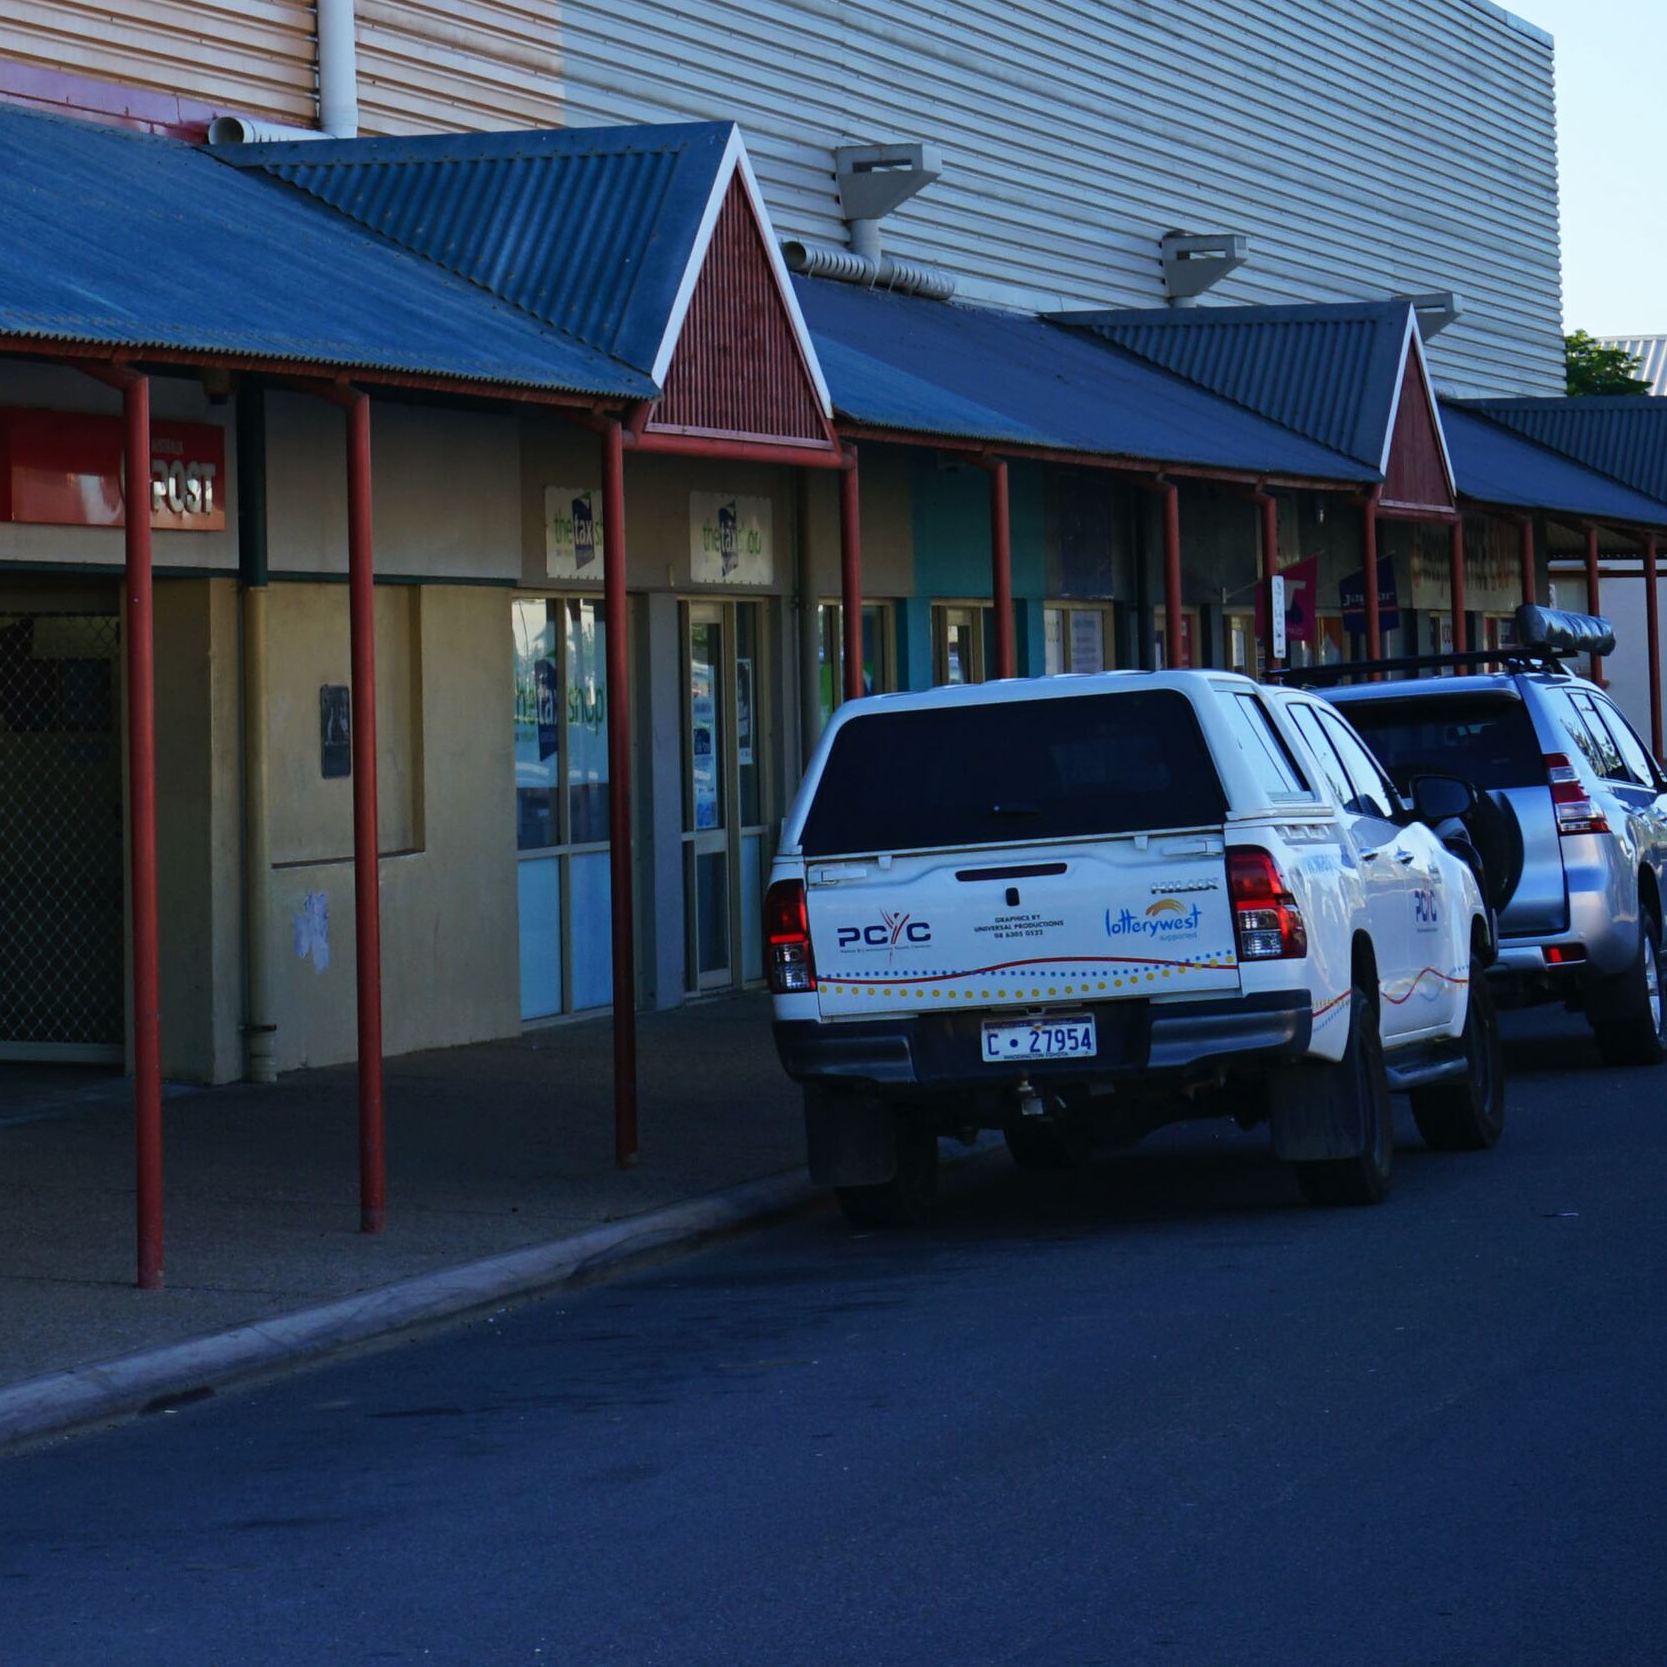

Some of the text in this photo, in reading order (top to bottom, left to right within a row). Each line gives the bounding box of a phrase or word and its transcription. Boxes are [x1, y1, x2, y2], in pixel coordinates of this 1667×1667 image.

[152, 459, 216, 513] POST
[574, 512, 593, 545] tax
[837, 910, 932, 948] PCYC
[974, 920, 1064, 933] UNIVERSAL PRODUCTIONS
[995, 914, 1030, 923] GRAPHICS
[1105, 903, 1203, 938] lotterywest
[1029, 1027, 1092, 1053] 27954
